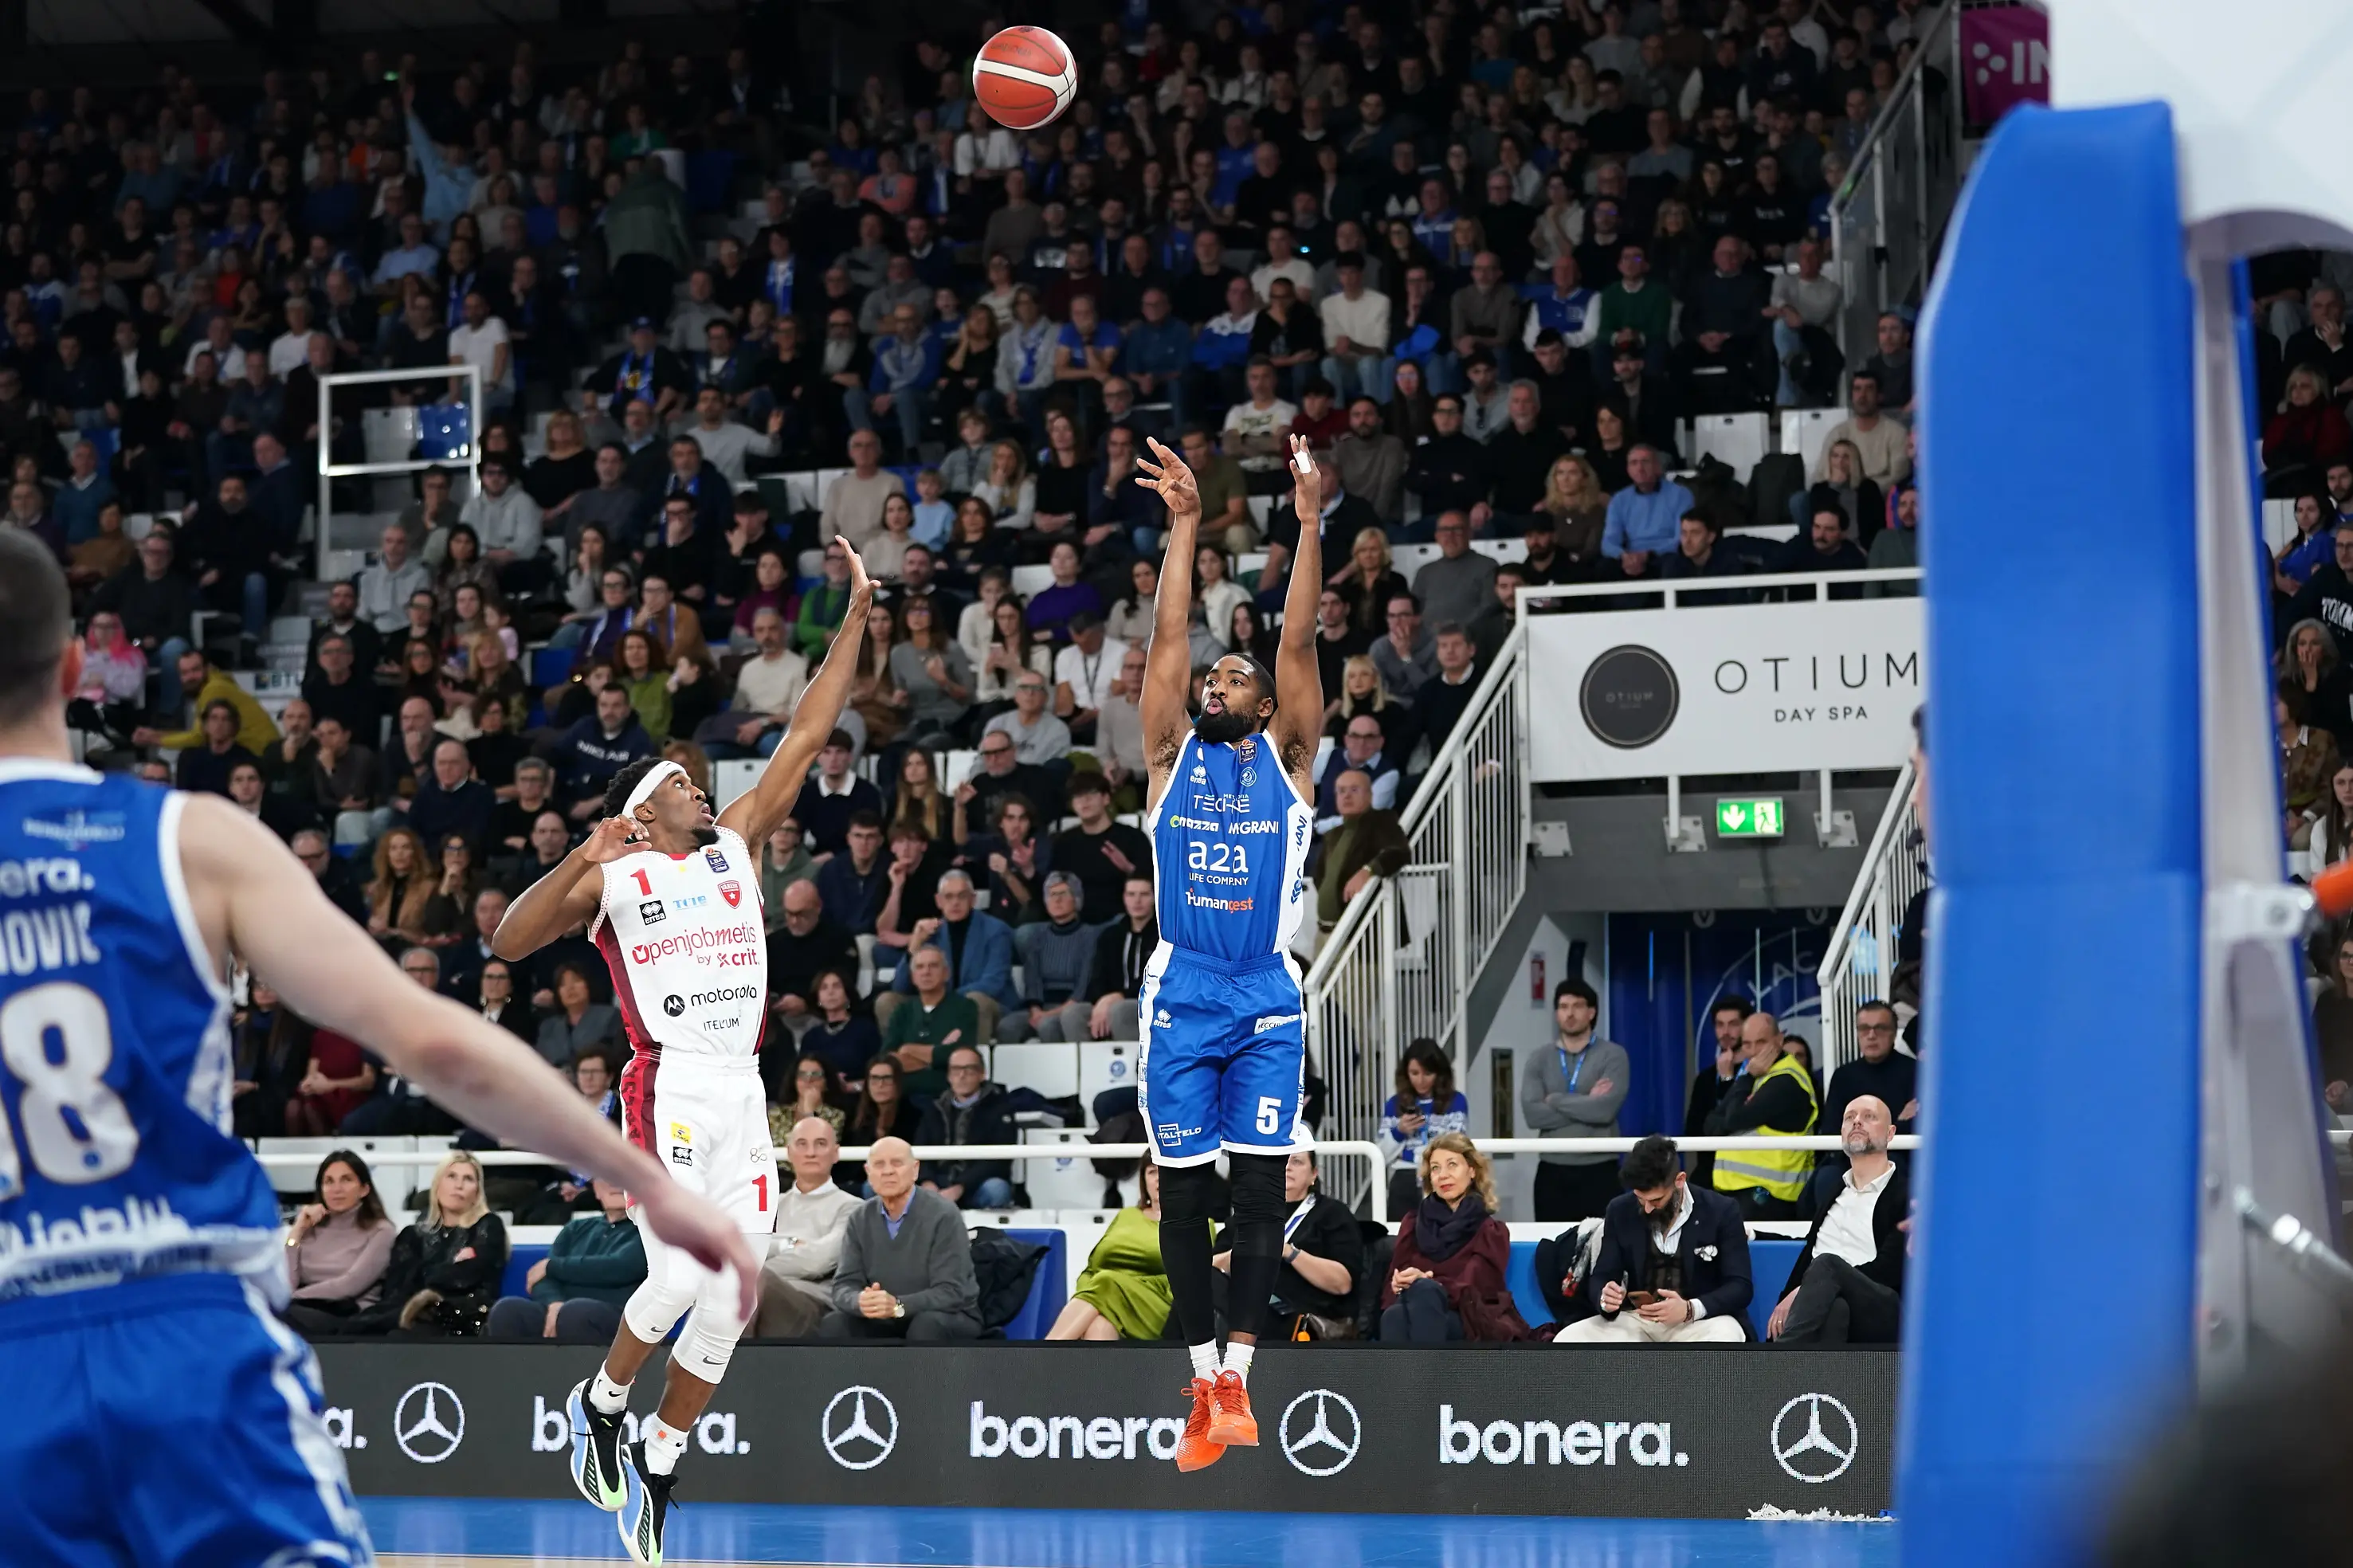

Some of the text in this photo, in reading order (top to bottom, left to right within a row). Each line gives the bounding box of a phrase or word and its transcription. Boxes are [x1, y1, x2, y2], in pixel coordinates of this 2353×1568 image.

[1715, 652, 1919, 694] OTIUM
[1775, 706, 1867, 723] DAY SPA
[1188, 841, 1249, 874] a2a
[630, 868, 652, 896] 1
[645, 913, 666, 925] errea
[697, 955, 712, 966] by
[691, 985, 757, 1006] motorola
[0, 982, 139, 1195] 8
[1256, 1096, 1281, 1135] 5
[752, 1174, 767, 1212] 1
[1439, 1404, 1688, 1466] bonera.
